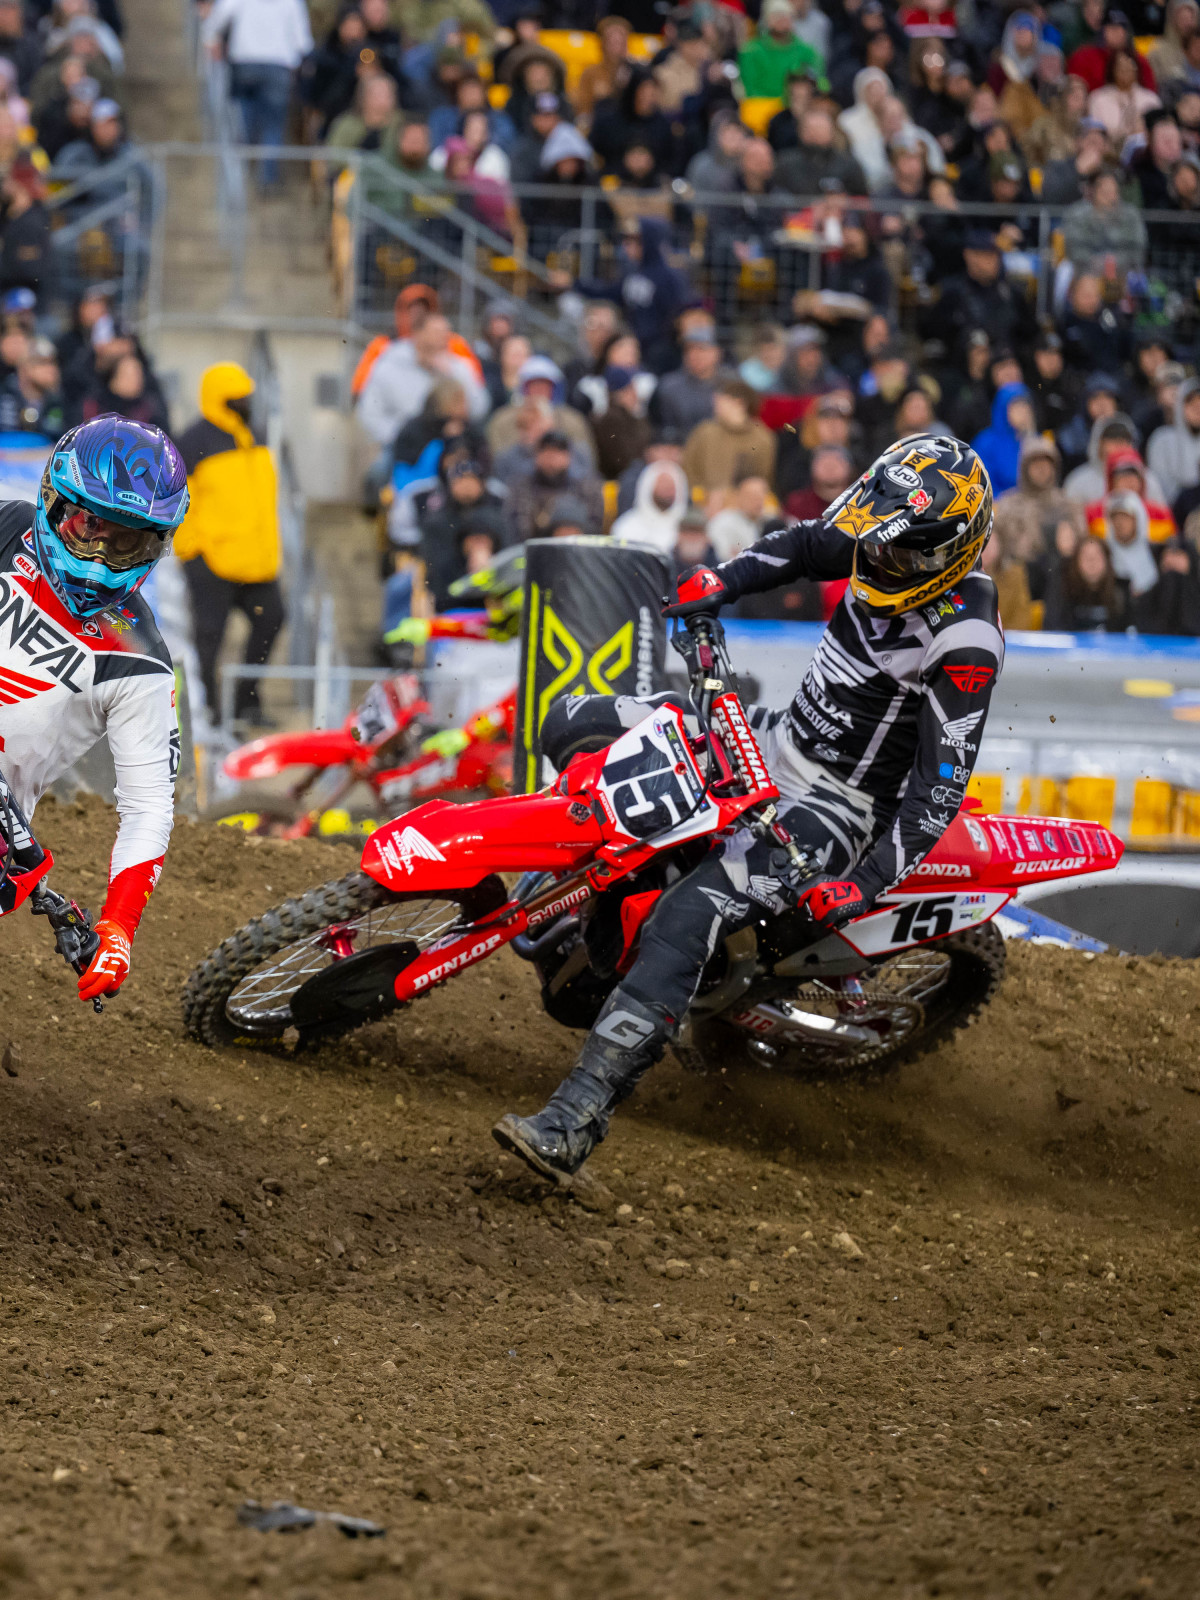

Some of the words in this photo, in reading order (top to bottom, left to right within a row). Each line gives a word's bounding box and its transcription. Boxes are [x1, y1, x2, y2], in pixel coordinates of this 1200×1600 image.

[892, 467, 918, 485] Arai
[121, 493, 145, 505] BELL
[15, 554, 38, 578] BELL
[724, 698, 770, 790] RENTHAL
[601, 735, 696, 839] 15
[599, 792, 615, 824] HONDA
[392, 830, 414, 876] HONDA
[1012, 856, 1087, 875] DUNLOP
[526, 885, 591, 927] SHOWA
[746, 886, 778, 911] HONDA
[821, 885, 853, 906] FLY
[890, 895, 957, 944] 15
[412, 934, 502, 991] DUNLOP
